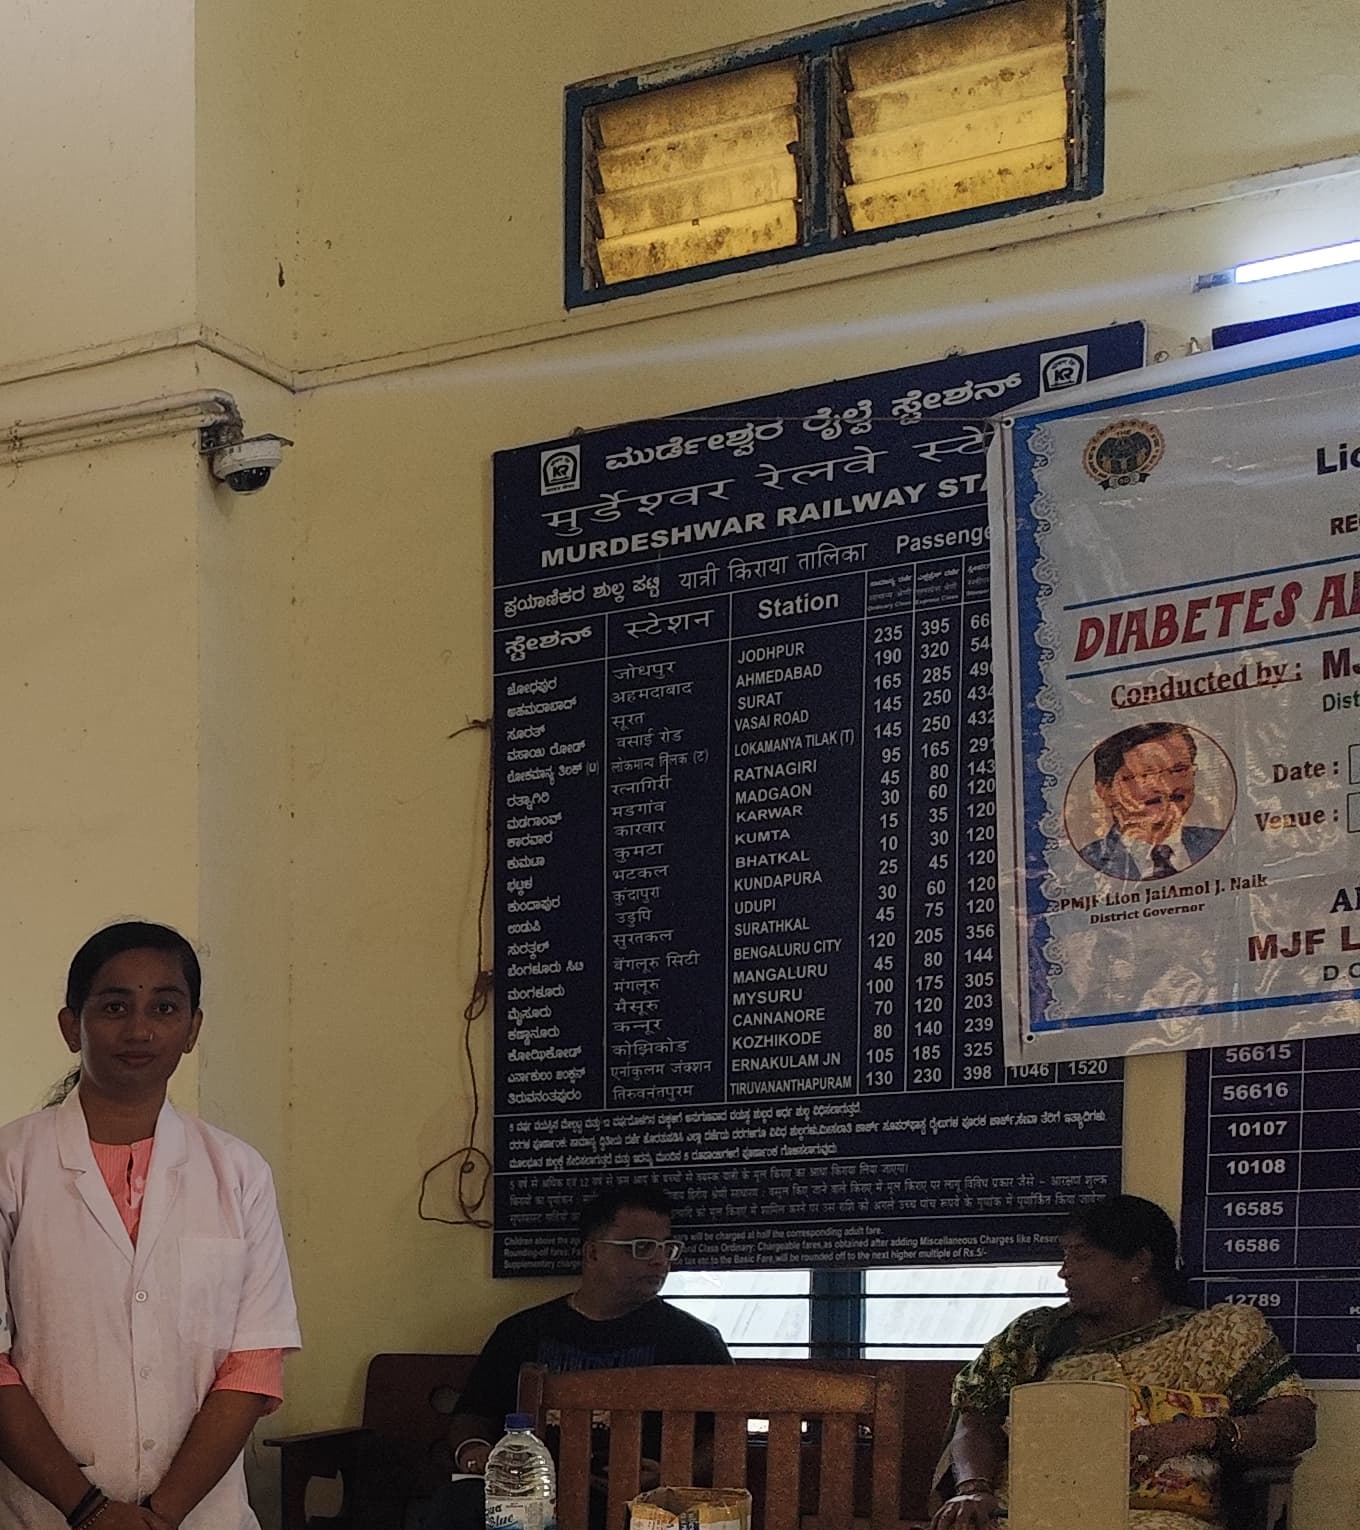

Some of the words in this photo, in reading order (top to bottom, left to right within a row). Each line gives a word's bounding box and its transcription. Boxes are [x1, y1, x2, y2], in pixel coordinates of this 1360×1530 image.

[892, 372, 1022, 420] ಸ್ಟೇಶನ್
[541, 489, 735, 537] मुर्डेश्वर
[755, 445, 888, 490] रेलवे
[542, 513, 766, 568] MURDESHWAR
[777, 482, 926, 526] RAILWAY
[1330, 514, 1360, 536] RE
[678, 562, 720, 589] यात्री
[727, 556, 789, 582] किराया
[796, 543, 868, 570] तालिका
[504, 585, 585, 618] ಪ್ರಯಾಣಿಕರ
[593, 582, 624, 602] ಶುಲ್ಕ
[758, 593, 838, 619] Station
[624, 609, 715, 639] स्टेशन
[1074, 581, 1303, 662] DIABETES
[506, 626, 592, 662] ಸ್ಟೇಶನ್
[738, 642, 804, 664] JODHPUR
[612, 661, 676, 680] जोधपुर
[736, 664, 822, 688] AHMEDABAD
[1110, 664, 1248, 708] Conducted
[1255, 661, 1289, 689] by
[738, 692, 783, 710] SURAT
[612, 712, 645, 730] सूरत
[734, 714, 770, 731] VASAI
[774, 710, 808, 726] ROAD
[735, 736, 802, 756] LOKAMANYA
[805, 731, 837, 748] TILAK
[840, 729, 854, 746] (T)
[734, 760, 816, 782] RATNAGIRI
[1272, 761, 1326, 783] Date
[736, 784, 811, 804] MADGAON
[736, 805, 802, 822] KARWAR
[1254, 808, 1326, 832] Venue
[735, 829, 790, 844] KUMTA
[613, 843, 664, 863] कुमटा
[736, 850, 810, 868] BHATKAL
[612, 865, 670, 881] भटकल
[734, 870, 822, 892] KUNDAPURA
[1105, 891, 1140, 907] Lion
[1145, 880, 1210, 904] JaiAmol
[1215, 880, 1226, 896] J.
[1230, 874, 1268, 892] Naik
[735, 898, 776, 914] UDUPI
[1090, 911, 1140, 924] District
[1143, 903, 1206, 918] Governor
[734, 918, 810, 936] SURATHKAL
[914, 928, 943, 944] 205
[966, 924, 994, 939] 356
[612, 930, 674, 949] सुरतकल
[734, 942, 810, 960] BENGALURU
[814, 938, 842, 953] CITY
[868, 932, 895, 948] 120
[1248, 928, 1326, 961] MJF
[734, 964, 827, 984] MANGALURU
[734, 988, 802, 1006] MYSURU
[733, 1008, 824, 1026] CANNANORE
[732, 1031, 821, 1050] KOZHIKODE
[732, 1054, 818, 1072] ERNAKULAM
[823, 1052, 840, 1065] JN
[1225, 1044, 1291, 1063] 56615
[914, 1068, 942, 1083] 230
[964, 1065, 992, 1080] 398
[1012, 1064, 1050, 1077] 1046
[1068, 1060, 1108, 1075] 1520
[730, 1076, 852, 1095] TIRUVANANTHAPURAM
[866, 1070, 892, 1086] 130
[1223, 1082, 1288, 1101] 56616
[1227, 1120, 1288, 1137] 10107
[1226, 1159, 1286, 1175] 10108
[1223, 1202, 1284, 1217] 16585
[980, 1235, 1014, 1246] Charges
[1223, 1238, 1280, 1253] 16586
